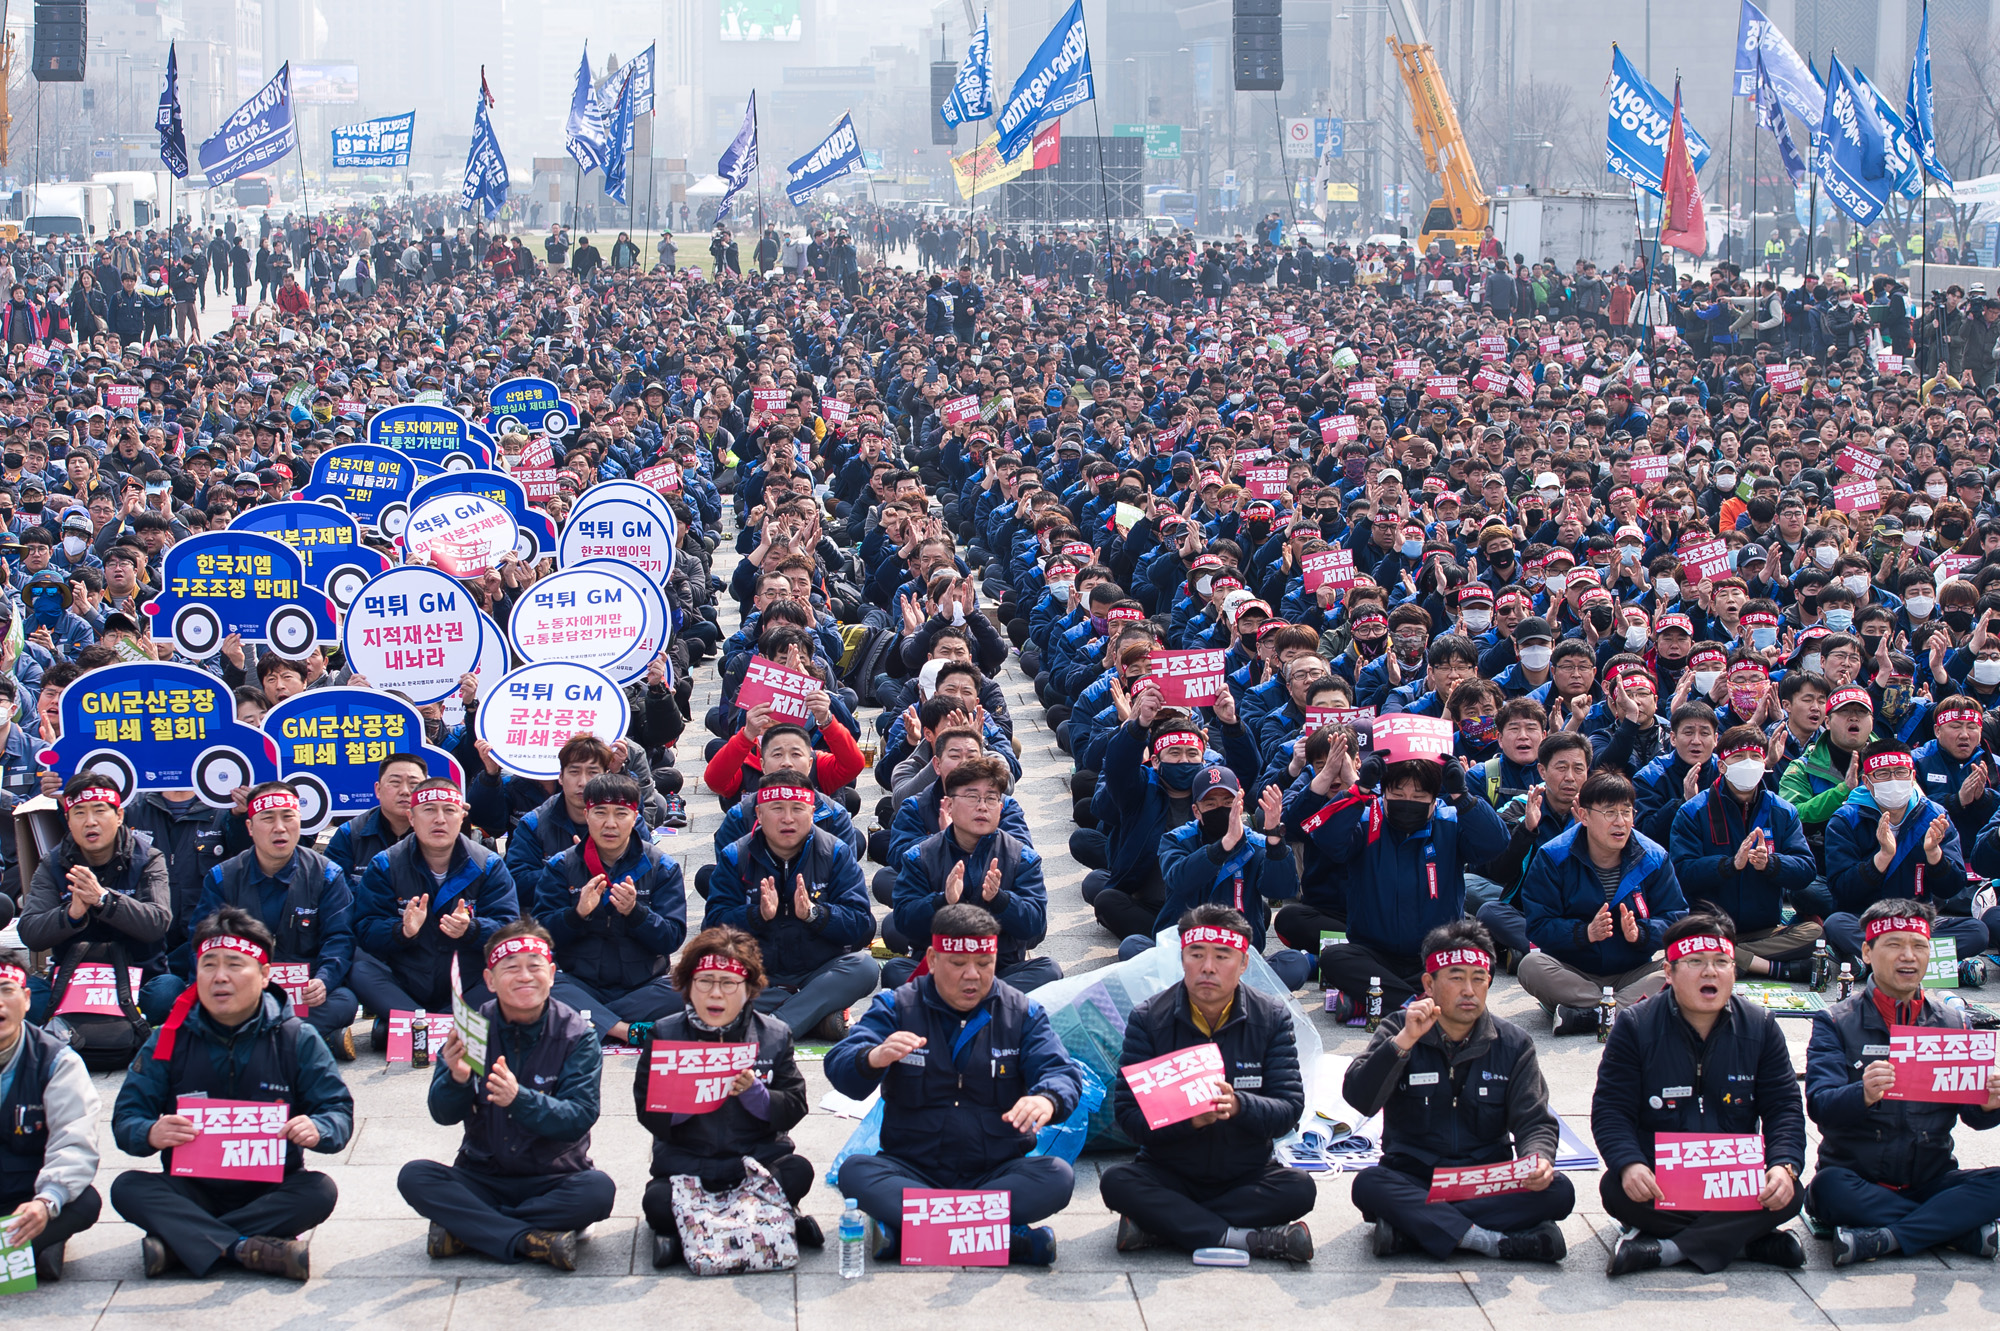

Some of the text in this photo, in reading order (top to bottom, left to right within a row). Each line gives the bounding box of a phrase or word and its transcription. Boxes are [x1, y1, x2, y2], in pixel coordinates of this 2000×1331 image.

[1427, 377, 1458, 388] 구조조정
[1478, 368, 1510, 386] 구조조정
[107, 385, 139, 397] 구조조정
[505, 389, 543, 402] 산업은행
[754, 390, 786, 401] 구조조정
[492, 400, 559, 415] 경영실사 제대로!
[821, 398, 850, 413] 구조조정
[946, 394, 978, 415] 구조조정
[380, 421, 459, 435] 노동자에게만
[1320, 415, 1356, 433] 구조조정
[378, 436, 460, 450] 고통전가반대!
[329, 456, 401, 475] 한국지엠 이익
[1630, 455, 1668, 470] 구조조정
[1843, 444, 1883, 470] 구조조정
[326, 471, 398, 490] 본사 빼돌리기
[512, 467, 557, 483] 구조조정
[1246, 469, 1288, 482] 구조조정
[344, 488, 373, 502] 그만!
[1834, 480, 1877, 501] 구조조정
[413, 501, 485, 534] 먹튀 GM
[415, 513, 507, 554] 외자본규제법
[578, 521, 652, 539] 먹튀 GM
[581, 545, 651, 557] 한국지엠이익
[1302, 549, 1353, 573] 구조조정
[1679, 540, 1727, 568] 구조조정
[196, 554, 272, 576] 한국지엠
[455, 555, 490, 572] 저지!
[1700, 556, 1731, 578] 저지!
[1323, 565, 1354, 583] 저지!
[171, 577, 298, 599] 구조조정 반대!
[365, 592, 456, 618] 먹튀 GM
[534, 588, 622, 609] 먹튀 GM
[536, 613, 622, 630] 노동자에게만
[363, 622, 463, 647] 지적재산권
[522, 626, 636, 646] 고통분담전가반대
[385, 647, 446, 670] 내놔라
[1151, 651, 1225, 678] 구조조정
[746, 662, 822, 698] 구조조정
[81, 689, 215, 714] GM군산공장
[509, 683, 603, 701] 먹튀 GM
[770, 692, 811, 720] 저지!
[282, 714, 406, 739] GM군산공장
[510, 708, 598, 727] 군산공장
[94, 717, 207, 742] 폐쇄 철회!
[1373, 718, 1453, 739] 구조조정
[292, 741, 396, 766] 폐쇄 철회!
[1409, 736, 1454, 754] 저지!
[1869, 754, 1889, 768] 단결
[1208, 769, 1221, 784] B
[761, 788, 812, 802] 단결 투쟁
[1871, 920, 1891, 934] 단결
[941, 938, 964, 952] 단결
[1184, 928, 1243, 949] 단결 투쟁
[1678, 938, 1704, 955] 단결
[1436, 951, 1462, 967] 단결
[268, 965, 309, 984] 조정
[1889, 1033, 1996, 1062] 구조조정
[651, 1044, 757, 1075] 구조조정
[1125, 1046, 1224, 1096] 구조조정
[176, 1106, 288, 1134] 구조조정
[221, 1139, 287, 1167] 저지!
[1655, 1137, 1764, 1171] 구조조정
[1432, 1154, 1537, 1188] 구조조정
[1702, 1169, 1766, 1200] 저지!
[903, 1192, 1010, 1226] 구조조정
[948, 1225, 1010, 1255] 저지!
